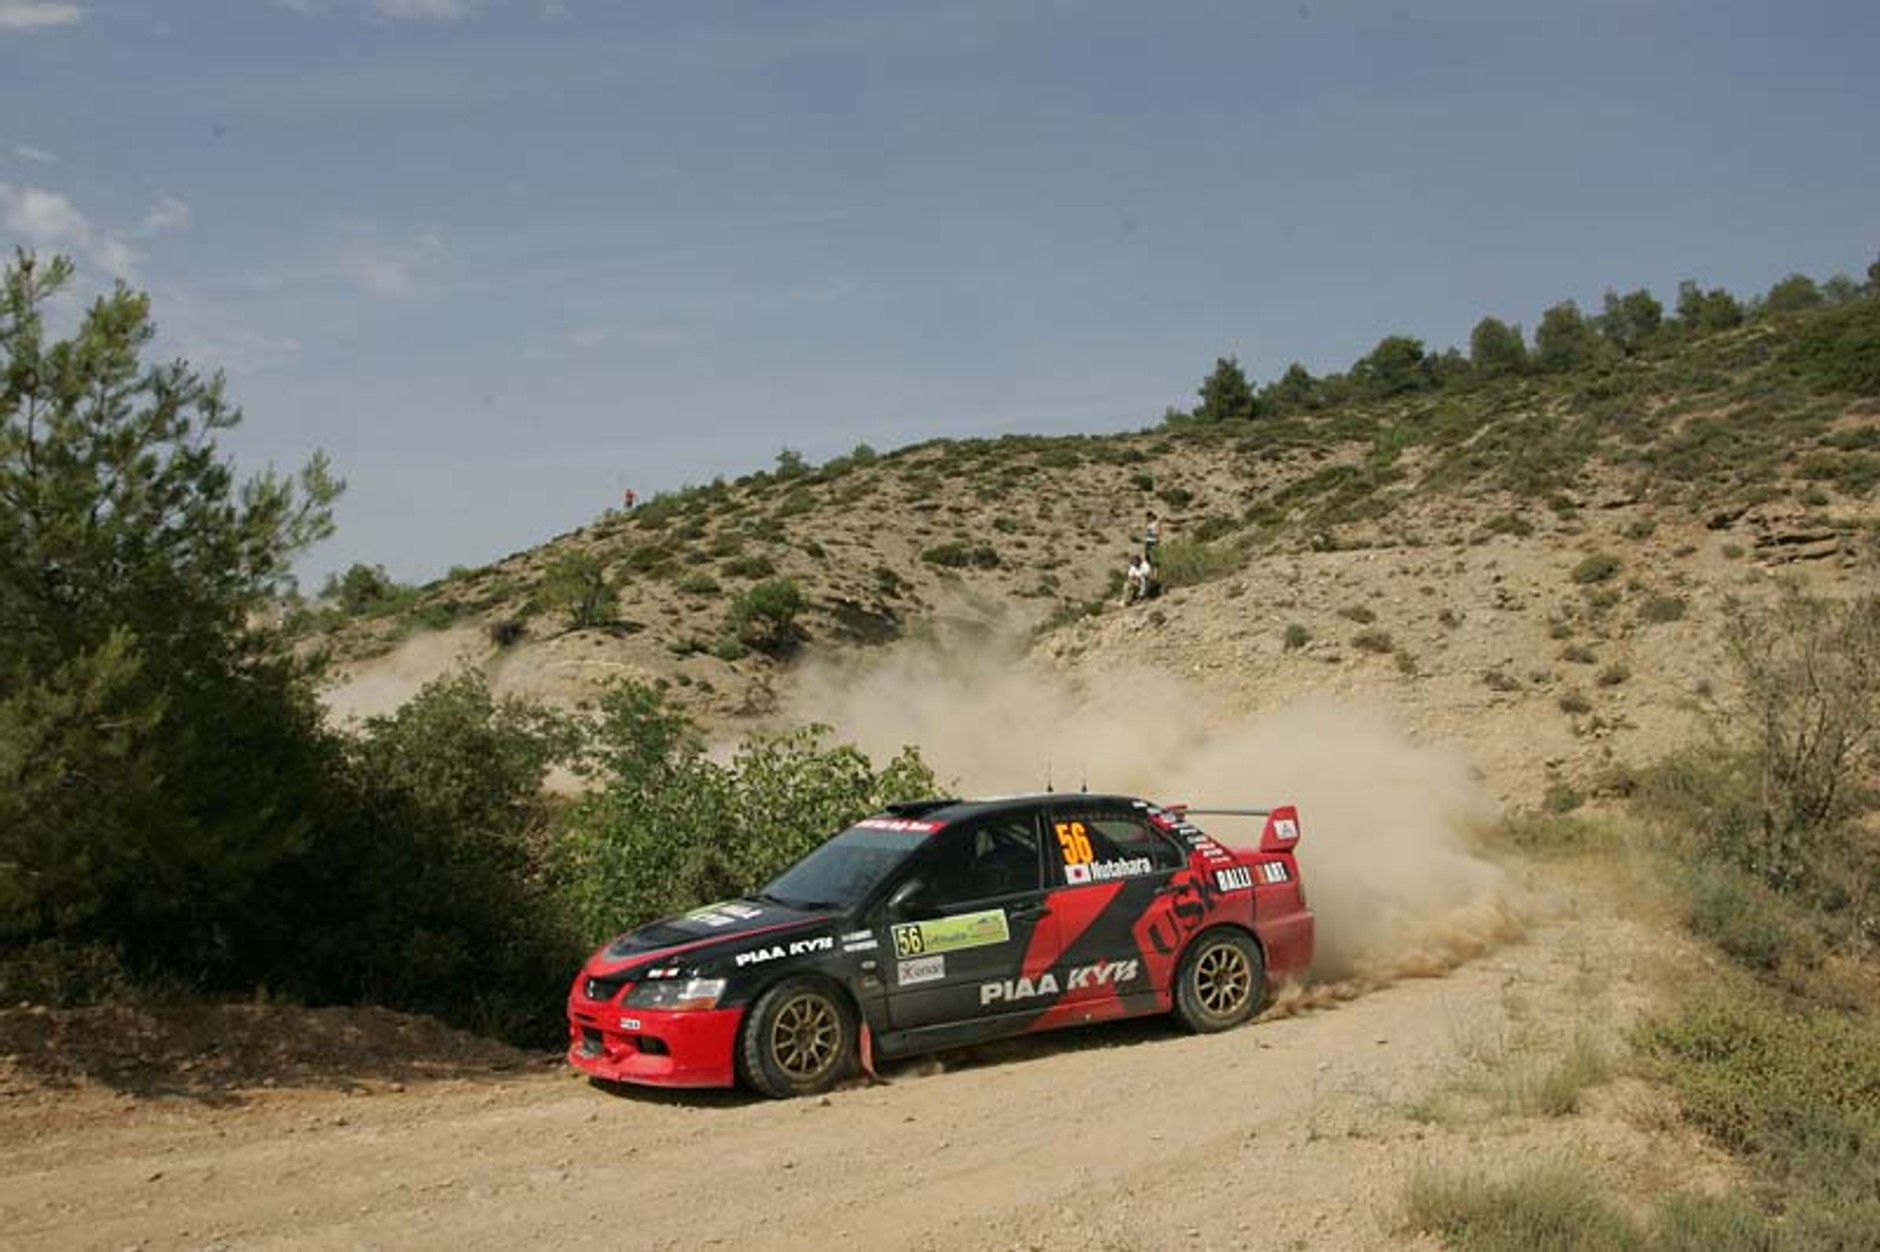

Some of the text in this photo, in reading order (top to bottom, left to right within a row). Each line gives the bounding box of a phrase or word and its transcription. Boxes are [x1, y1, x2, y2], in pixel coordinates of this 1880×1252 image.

[1055, 821, 1094, 865] 56
[735, 946, 787, 967] PIAA
[897, 926, 922, 957] 56
[980, 959, 1139, 1005] PIAA KYB
